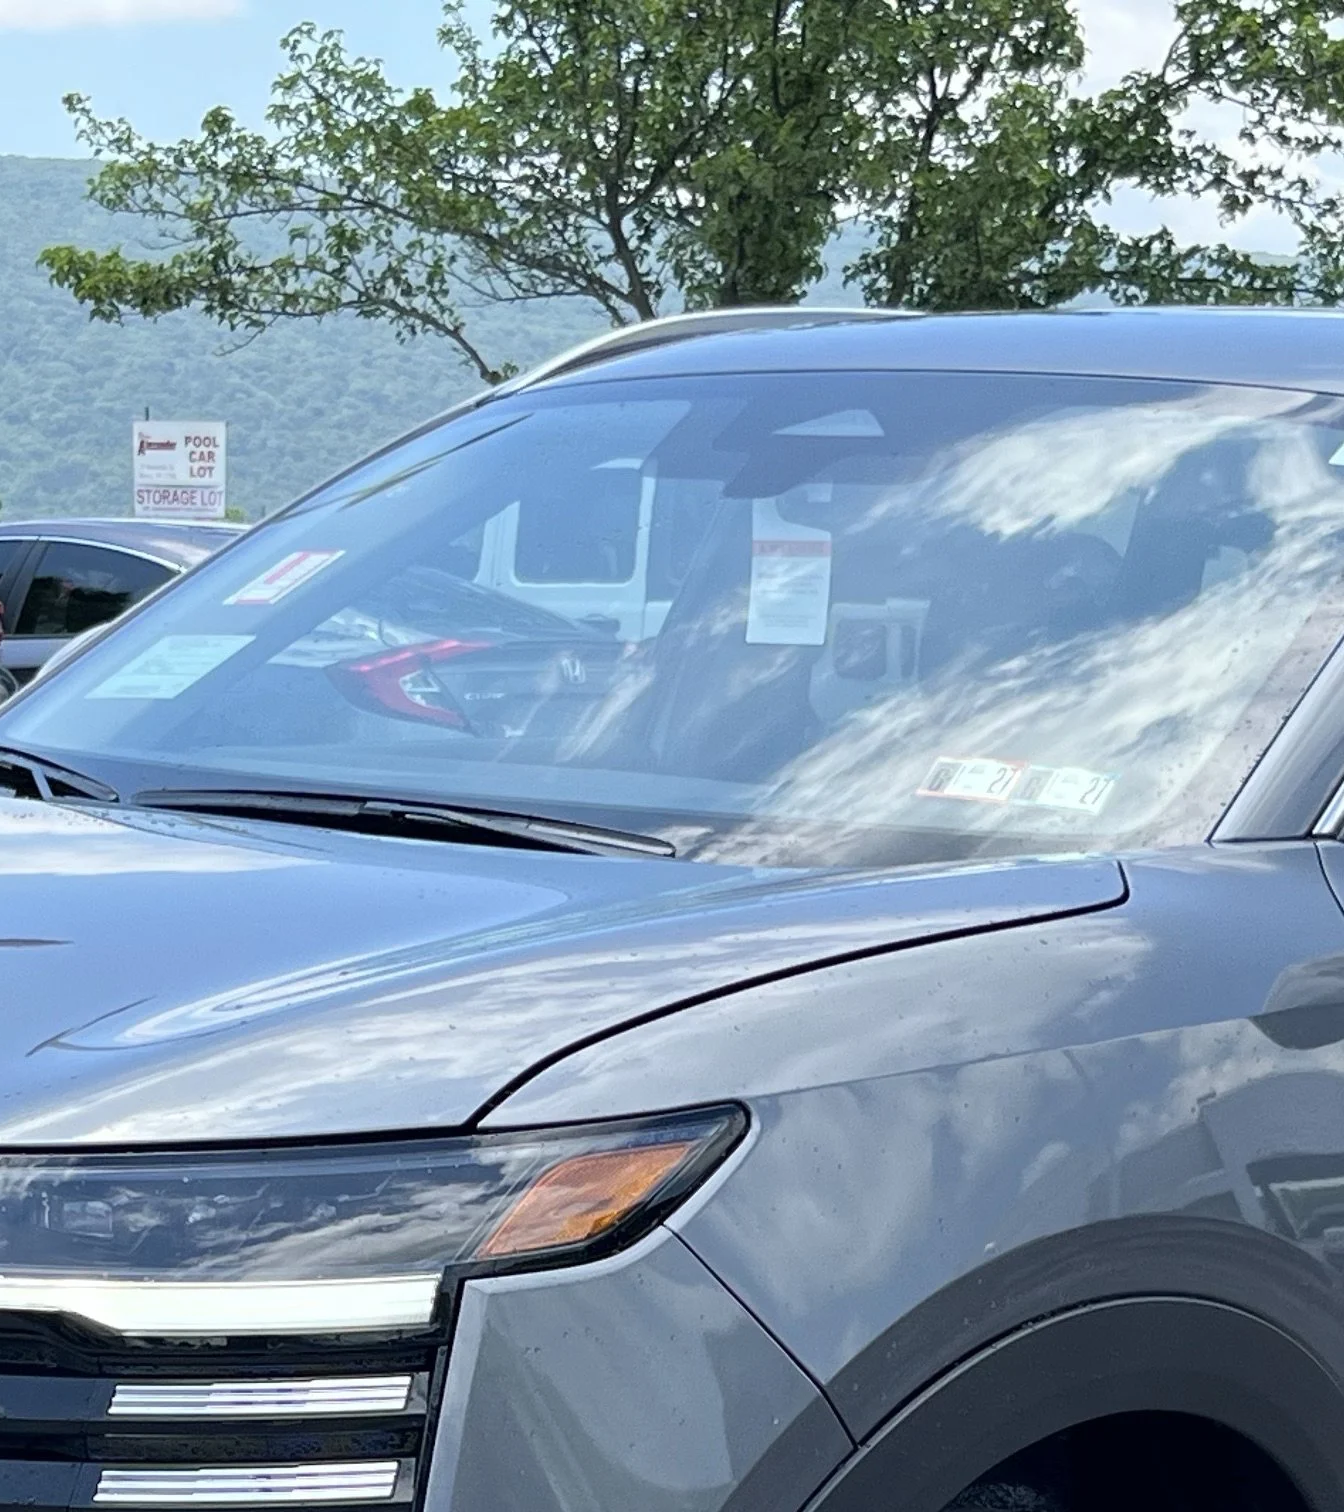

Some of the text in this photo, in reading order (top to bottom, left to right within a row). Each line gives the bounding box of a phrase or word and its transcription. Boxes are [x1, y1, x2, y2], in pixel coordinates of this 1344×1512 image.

[184, 436, 220, 448] POOL
[189, 451, 216, 463] CAR
[189, 466, 216, 478] LOT
[137, 489, 224, 506] STORAGE LOT
[986, 766, 1020, 794] 27
[1078, 776, 1113, 805] 27
